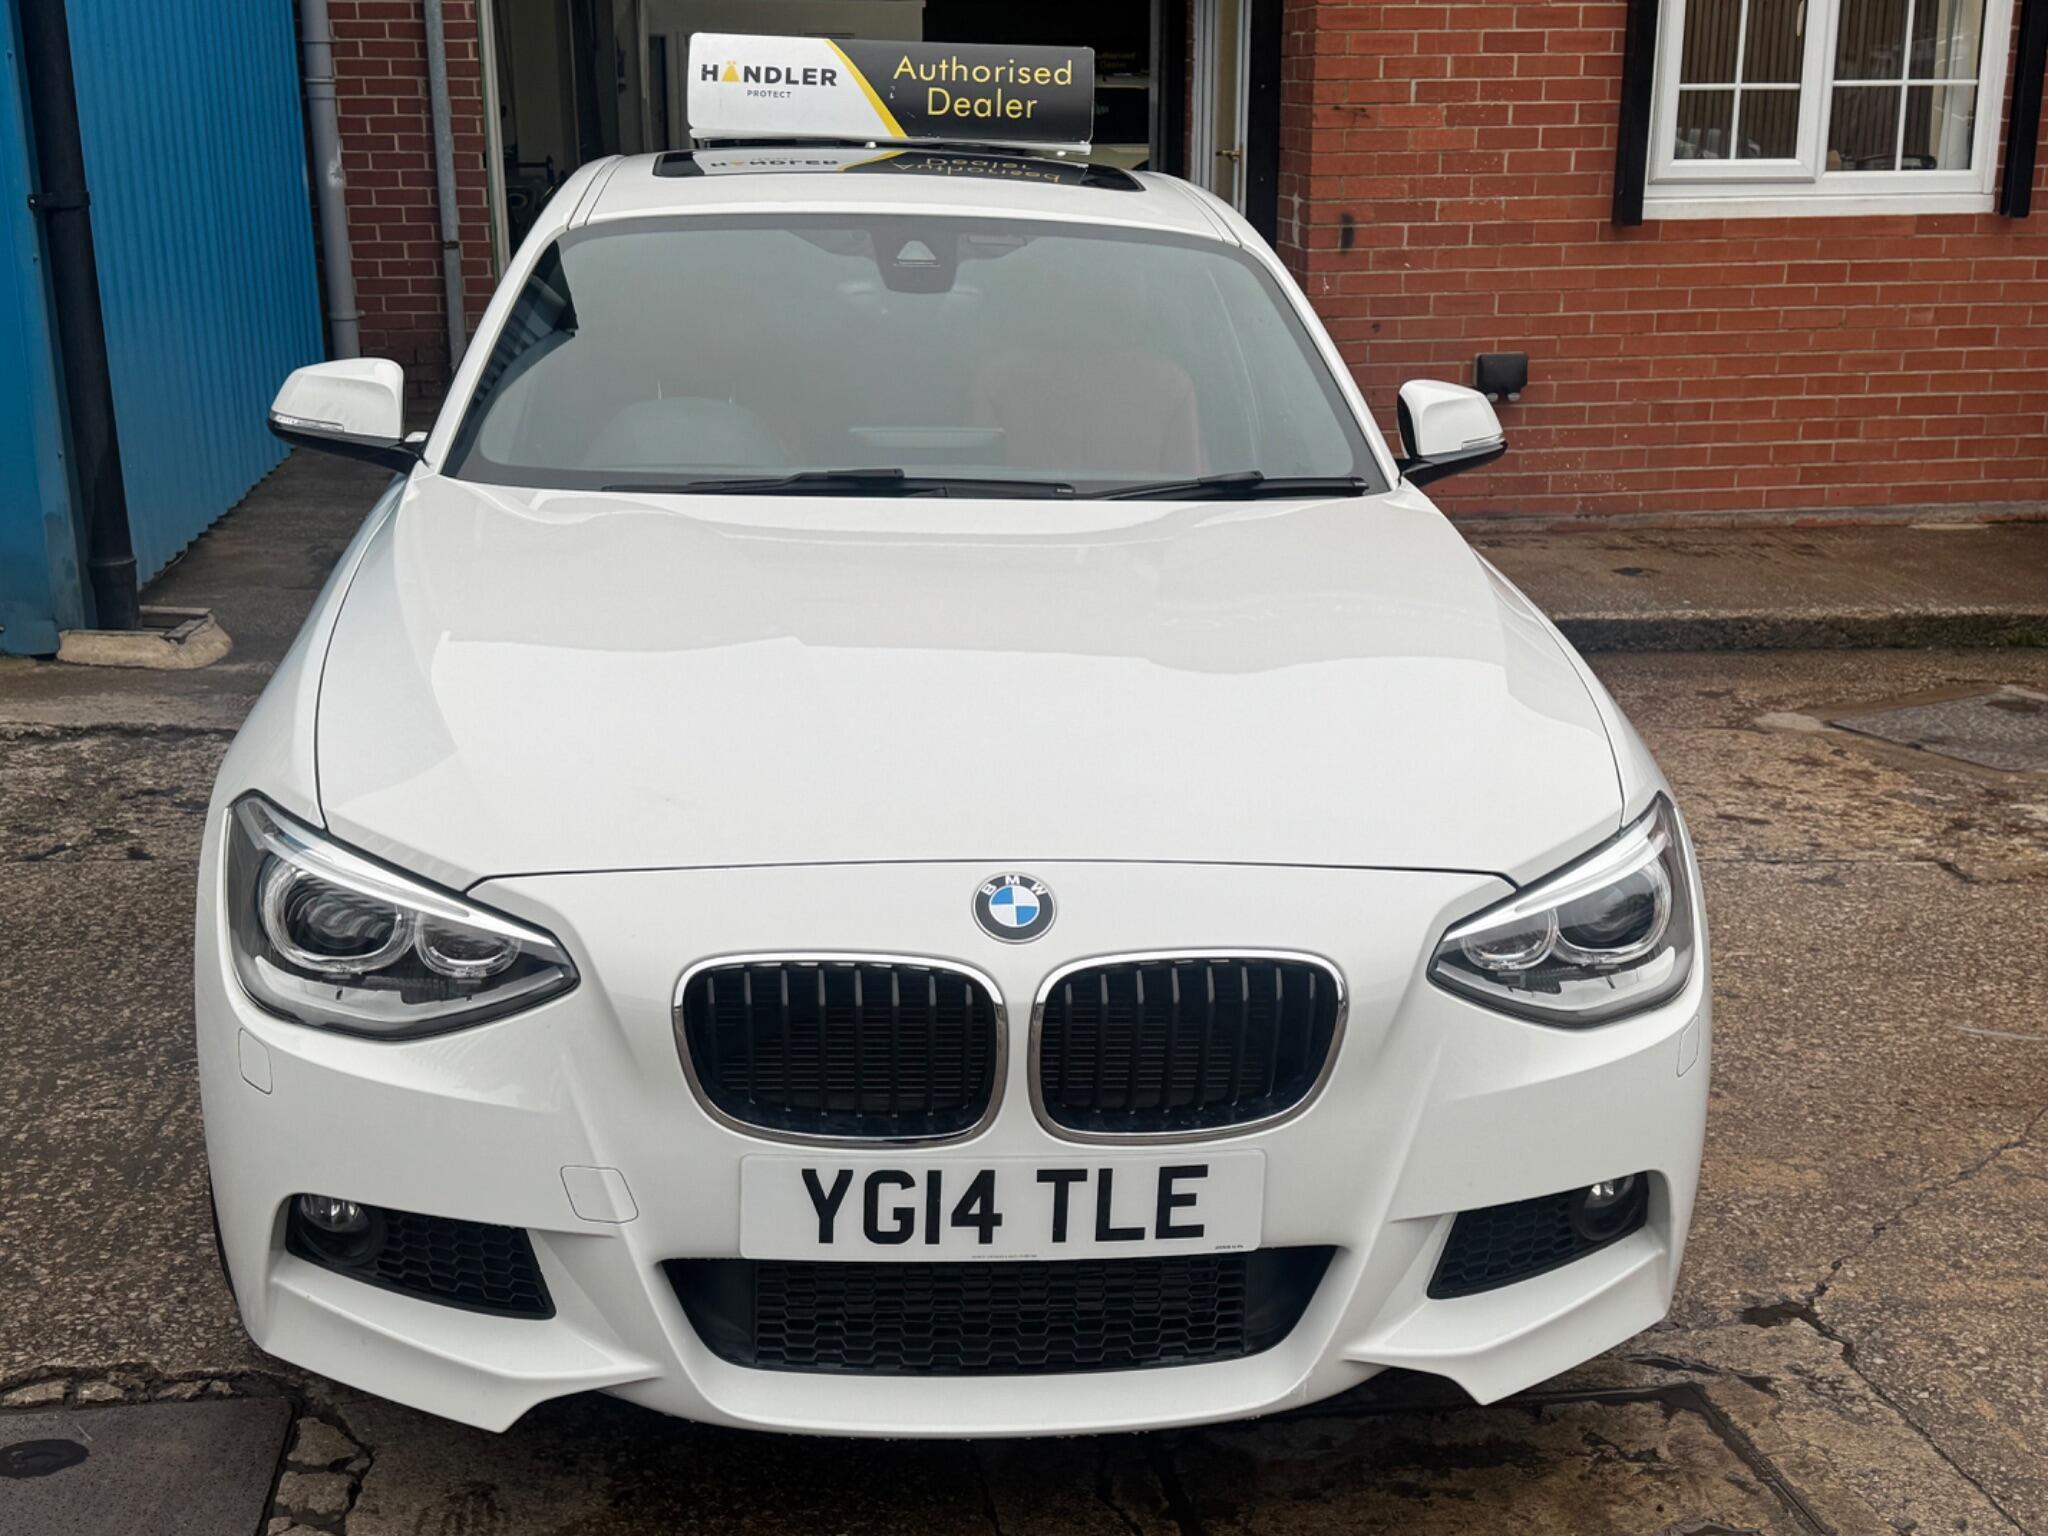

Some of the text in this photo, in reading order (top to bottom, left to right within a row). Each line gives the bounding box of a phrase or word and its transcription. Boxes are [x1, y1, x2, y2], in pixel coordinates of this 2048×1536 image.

[893, 55, 1072, 85] Authorised
[746, 89, 792, 99] PROTECT
[928, 87, 1038, 119] Dealer
[980, 875, 1049, 896] BMW
[801, 1163, 1209, 1245] YG14 TLE
